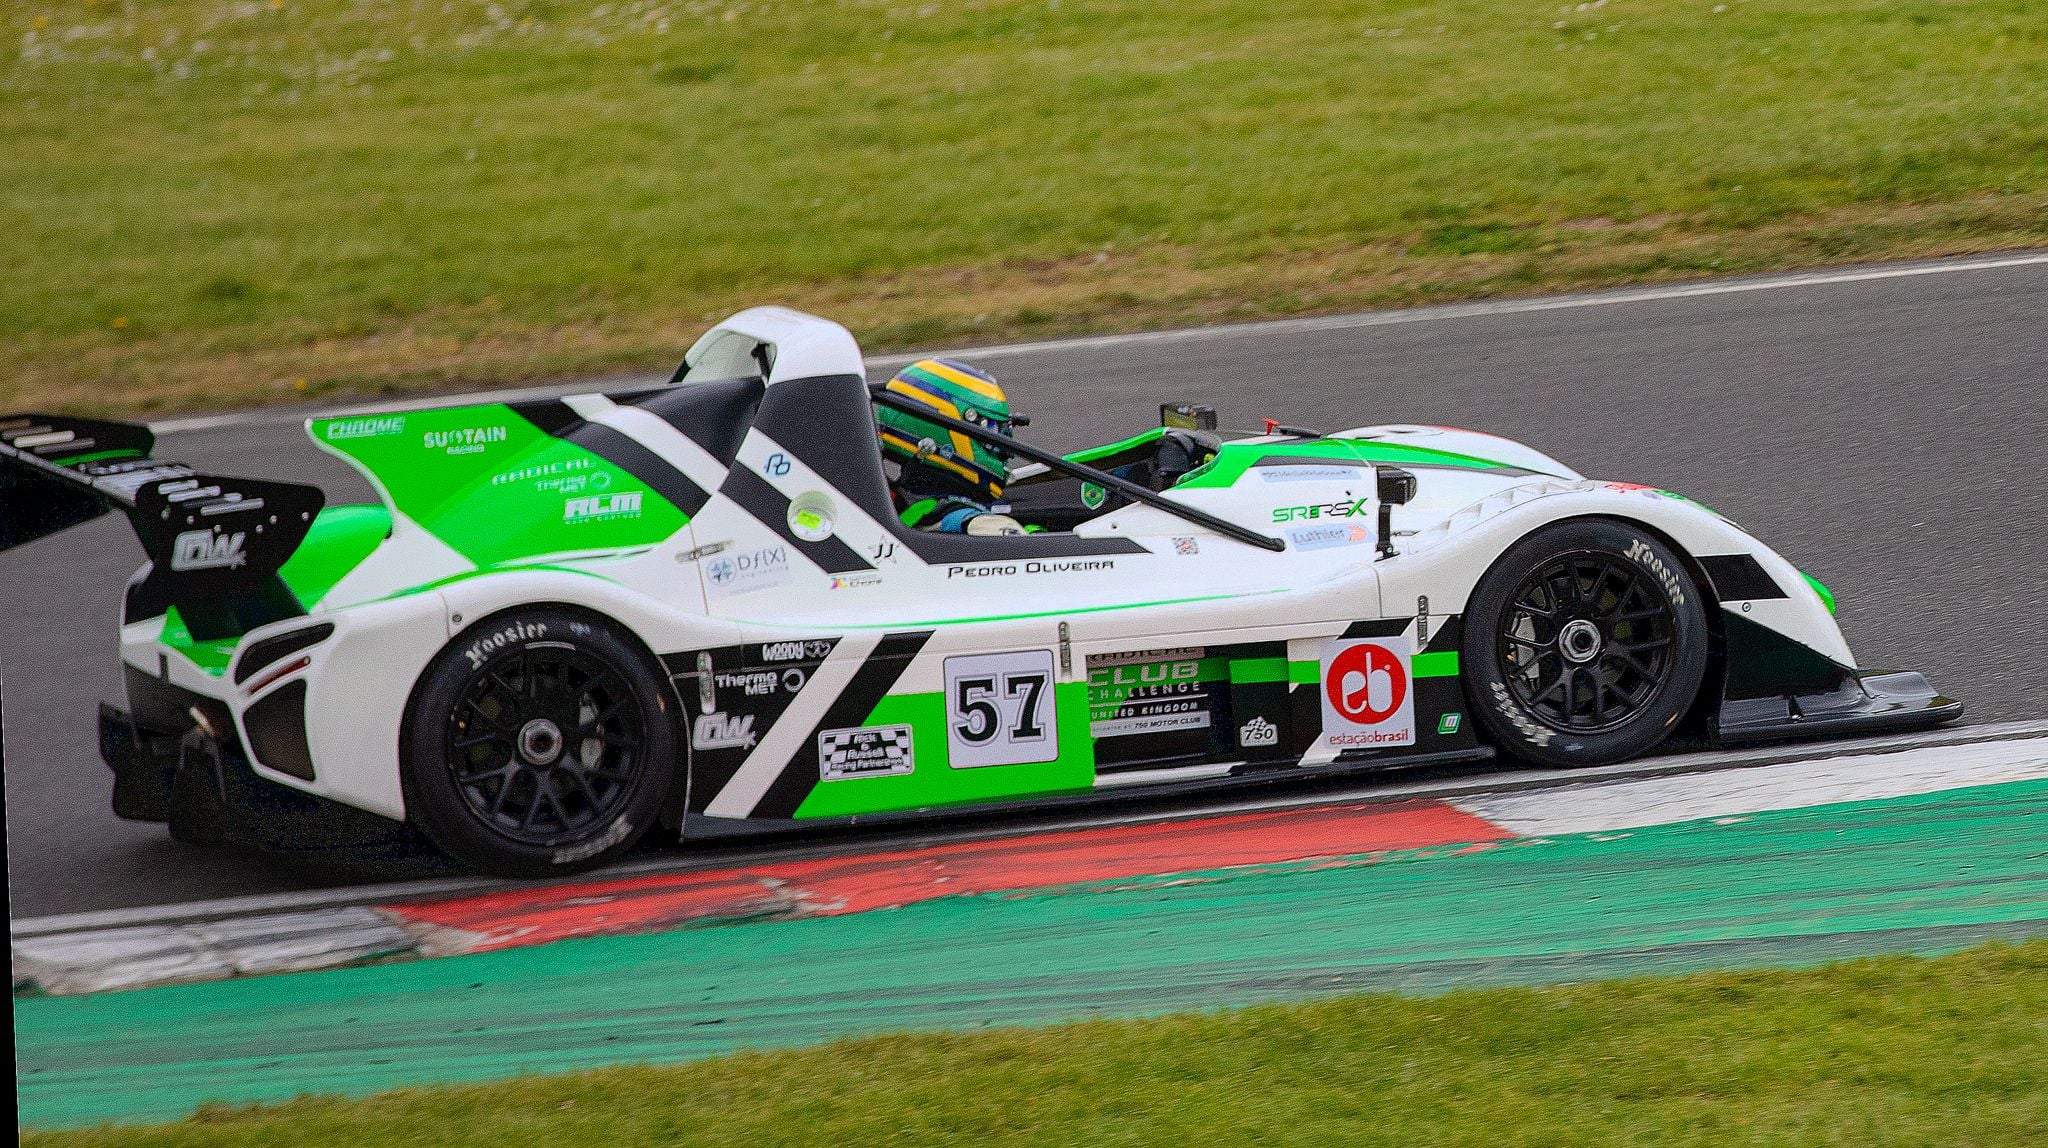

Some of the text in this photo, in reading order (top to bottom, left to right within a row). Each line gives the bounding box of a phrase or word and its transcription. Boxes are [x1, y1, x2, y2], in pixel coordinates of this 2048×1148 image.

[1025, 560, 1115, 574] OLIVEIRA
[1086, 662, 1199, 687] CLUB
[744, 683, 778, 696] MET
[954, 671, 1048, 746] 57
[1091, 701, 1199, 719] UNITED KINGDOM
[1243, 726, 1274, 741] 750
[1329, 728, 1409, 746] estaçãobrasil
